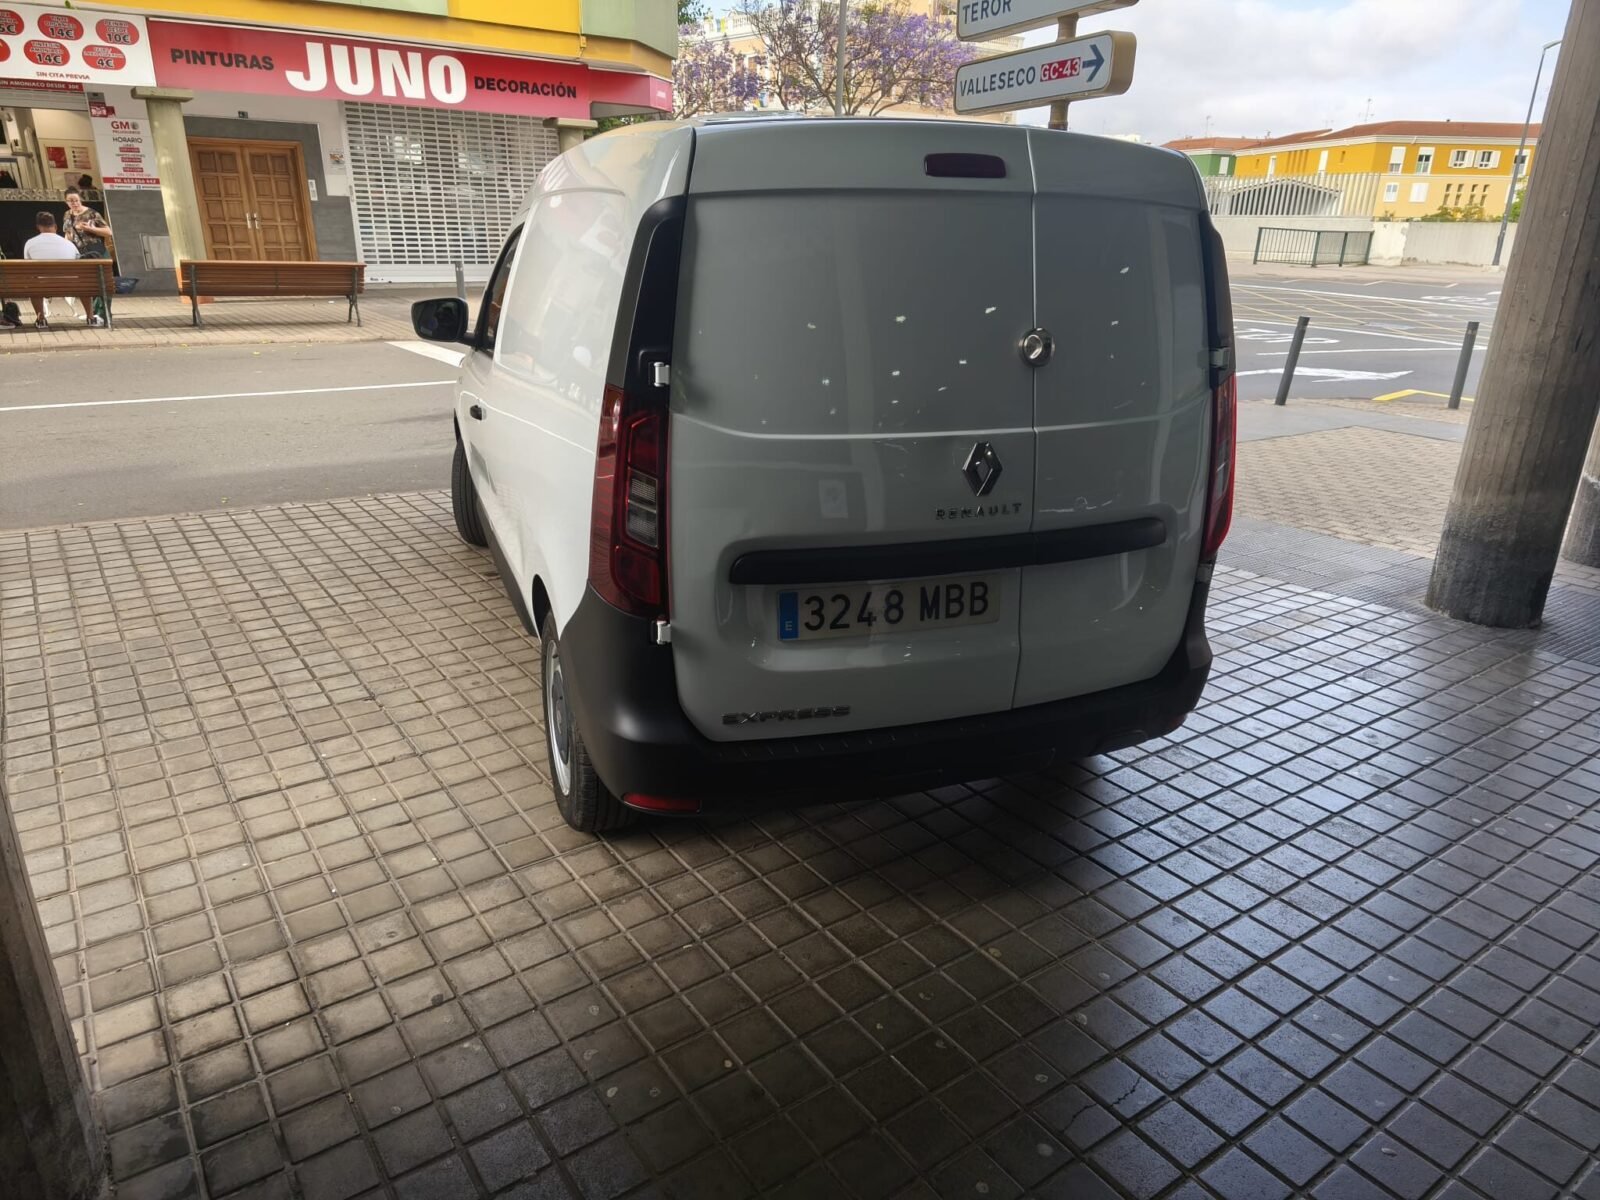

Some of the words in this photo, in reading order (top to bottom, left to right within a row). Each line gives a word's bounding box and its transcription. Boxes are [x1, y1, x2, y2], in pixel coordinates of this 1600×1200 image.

[963, 0, 1011, 24] TEROR
[49, 27, 74, 39] 14€
[107, 33, 130, 43] 10€
[36, 53, 62, 64] 14€
[97, 58, 114, 68] 4€
[170, 48, 274, 71] PINTURAS
[285, 42, 467, 104] JUNO
[960, 66, 1036, 97] VALLESECO
[1041, 58, 1080, 81] GC-43
[474, 76, 576, 98] DECORACIÓN
[111, 121, 130, 130] GM
[935, 502, 1022, 520] RENAULT
[785, 620, 793, 631] E
[804, 589, 904, 631] 3248
[919, 581, 989, 621] MBB
[722, 705, 851, 725] EXPRESS
